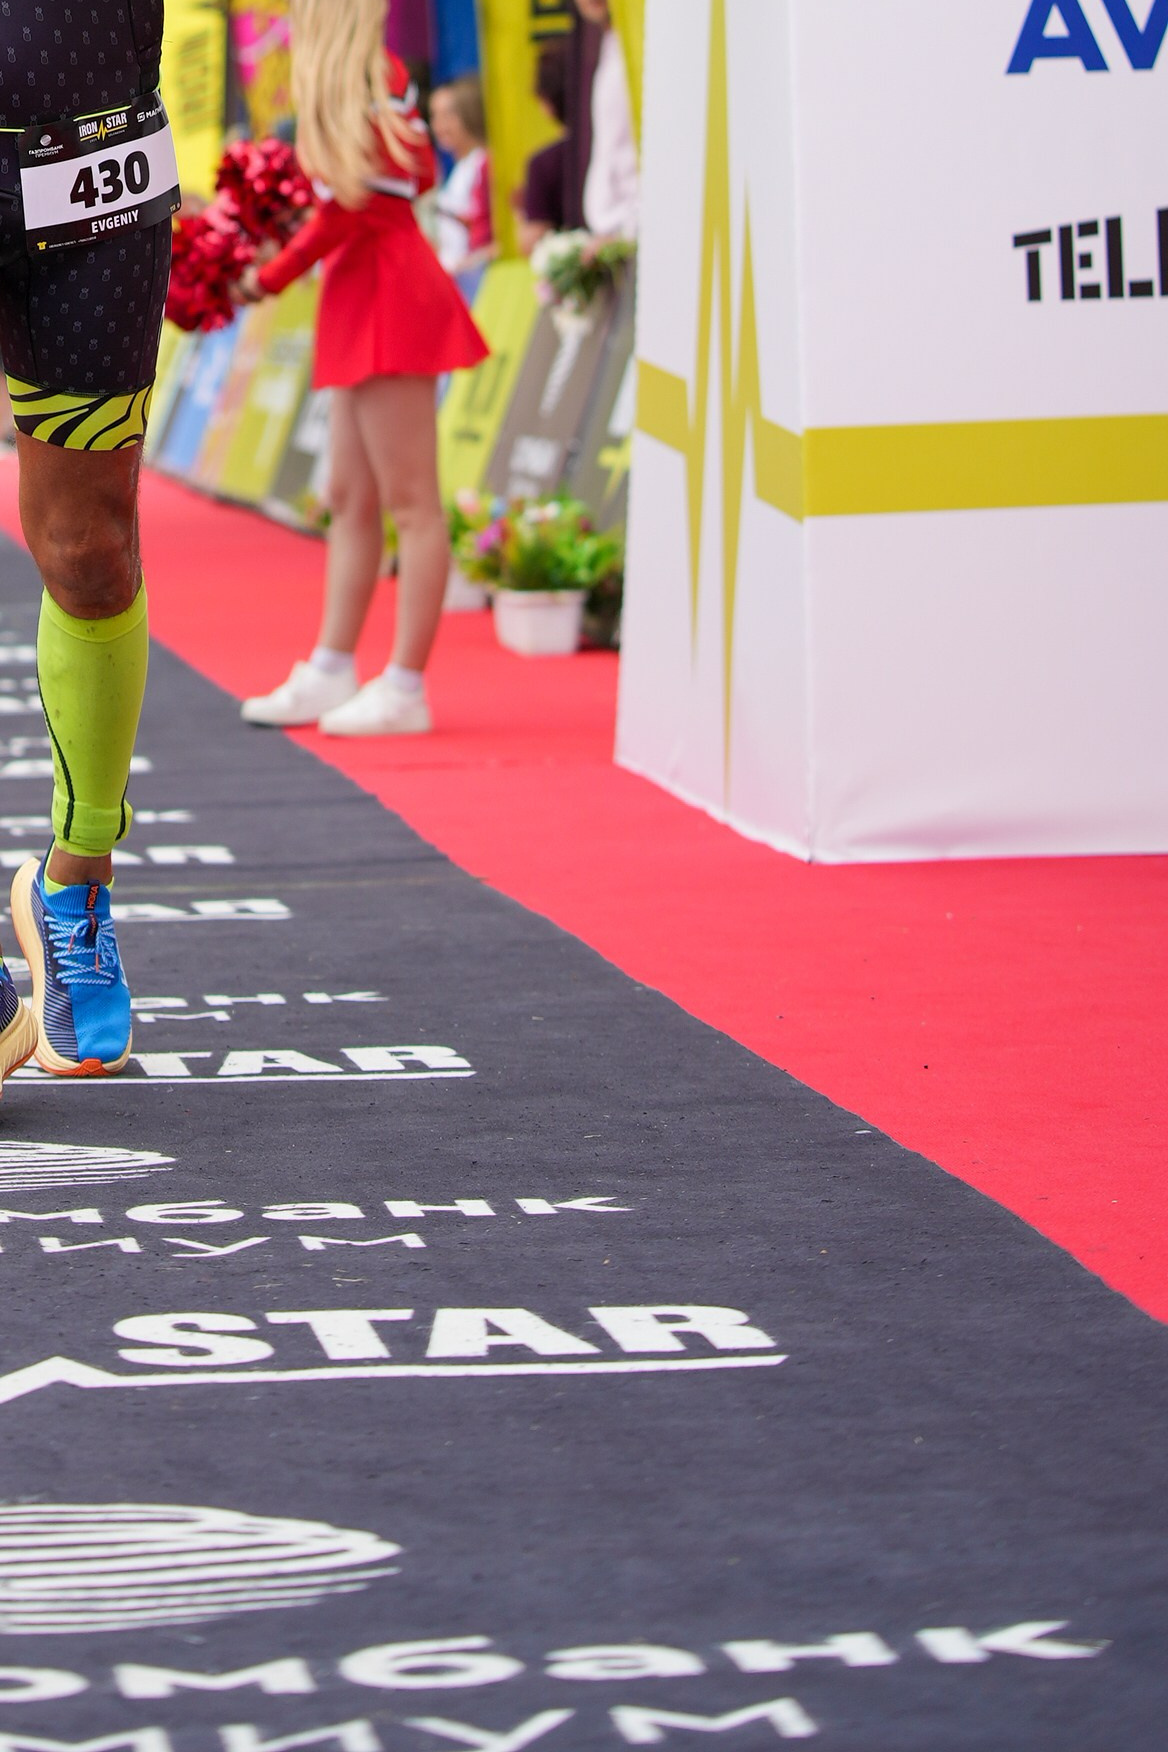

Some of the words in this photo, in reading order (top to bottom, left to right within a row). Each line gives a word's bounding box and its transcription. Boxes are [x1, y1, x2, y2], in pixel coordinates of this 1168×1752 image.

[78, 120, 99, 138] IRON
[105, 112, 128, 129] STAR
[69, 150, 151, 209] 430
[91, 209, 140, 234] EVGENIY
[1013, 206, 1168, 303] TEL
[86, 885, 100, 909] HOKA
[14, 1044, 473, 1079] TAR
[112, 1304, 777, 1367] STAR
